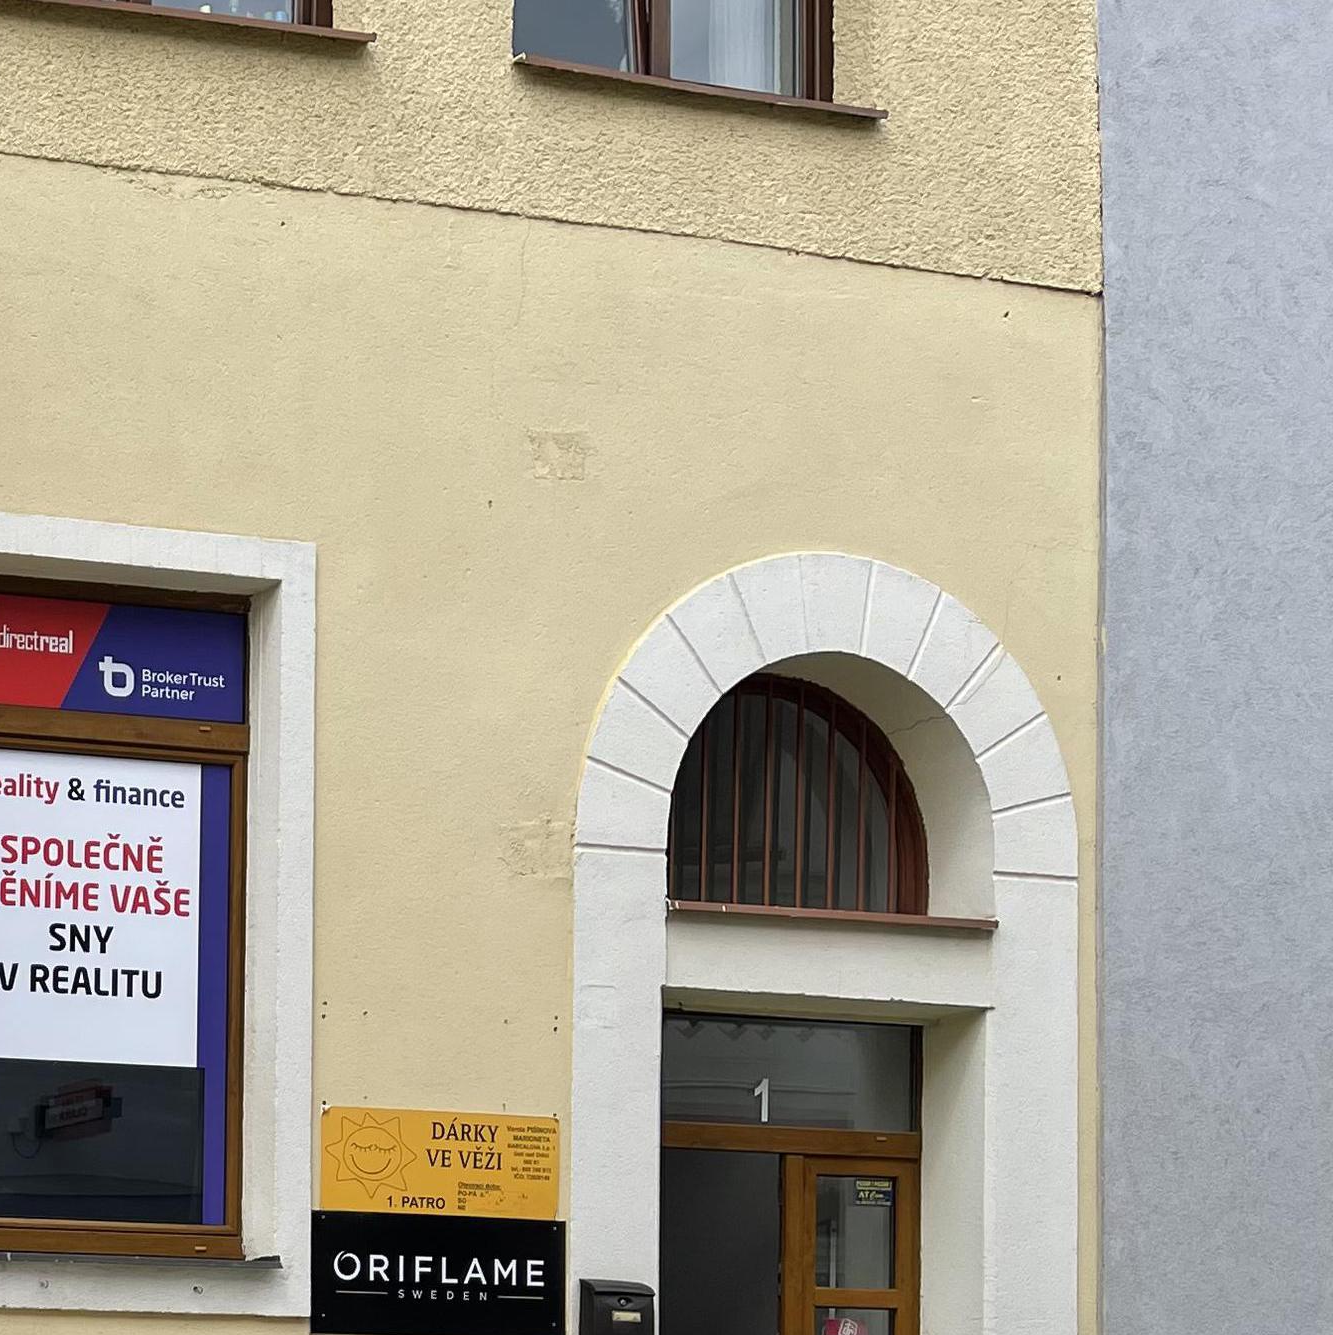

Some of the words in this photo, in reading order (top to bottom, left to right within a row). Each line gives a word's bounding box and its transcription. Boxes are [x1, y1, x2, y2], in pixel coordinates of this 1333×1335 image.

[141, 685, 195, 701] Partner
[67, 777, 86, 802] &
[93, 778, 186, 809] finance
[0, 833, 164, 875] SPOLEČNĚ
[110, 880, 192, 918] VAŠE
[48, 922, 115, 955] SNY
[30, 963, 163, 1000] REALITU
[431, 1116, 500, 1145] DÁRKY
[426, 1148, 452, 1168] VE
[457, 1145, 503, 1172] VĚŽI
[387, 1195, 398, 1209] 1.
[401, 1196, 446, 1210] PATRO
[333, 1250, 545, 1288] ORIFLAME
[397, 1289, 488, 1301] SWEDEN
